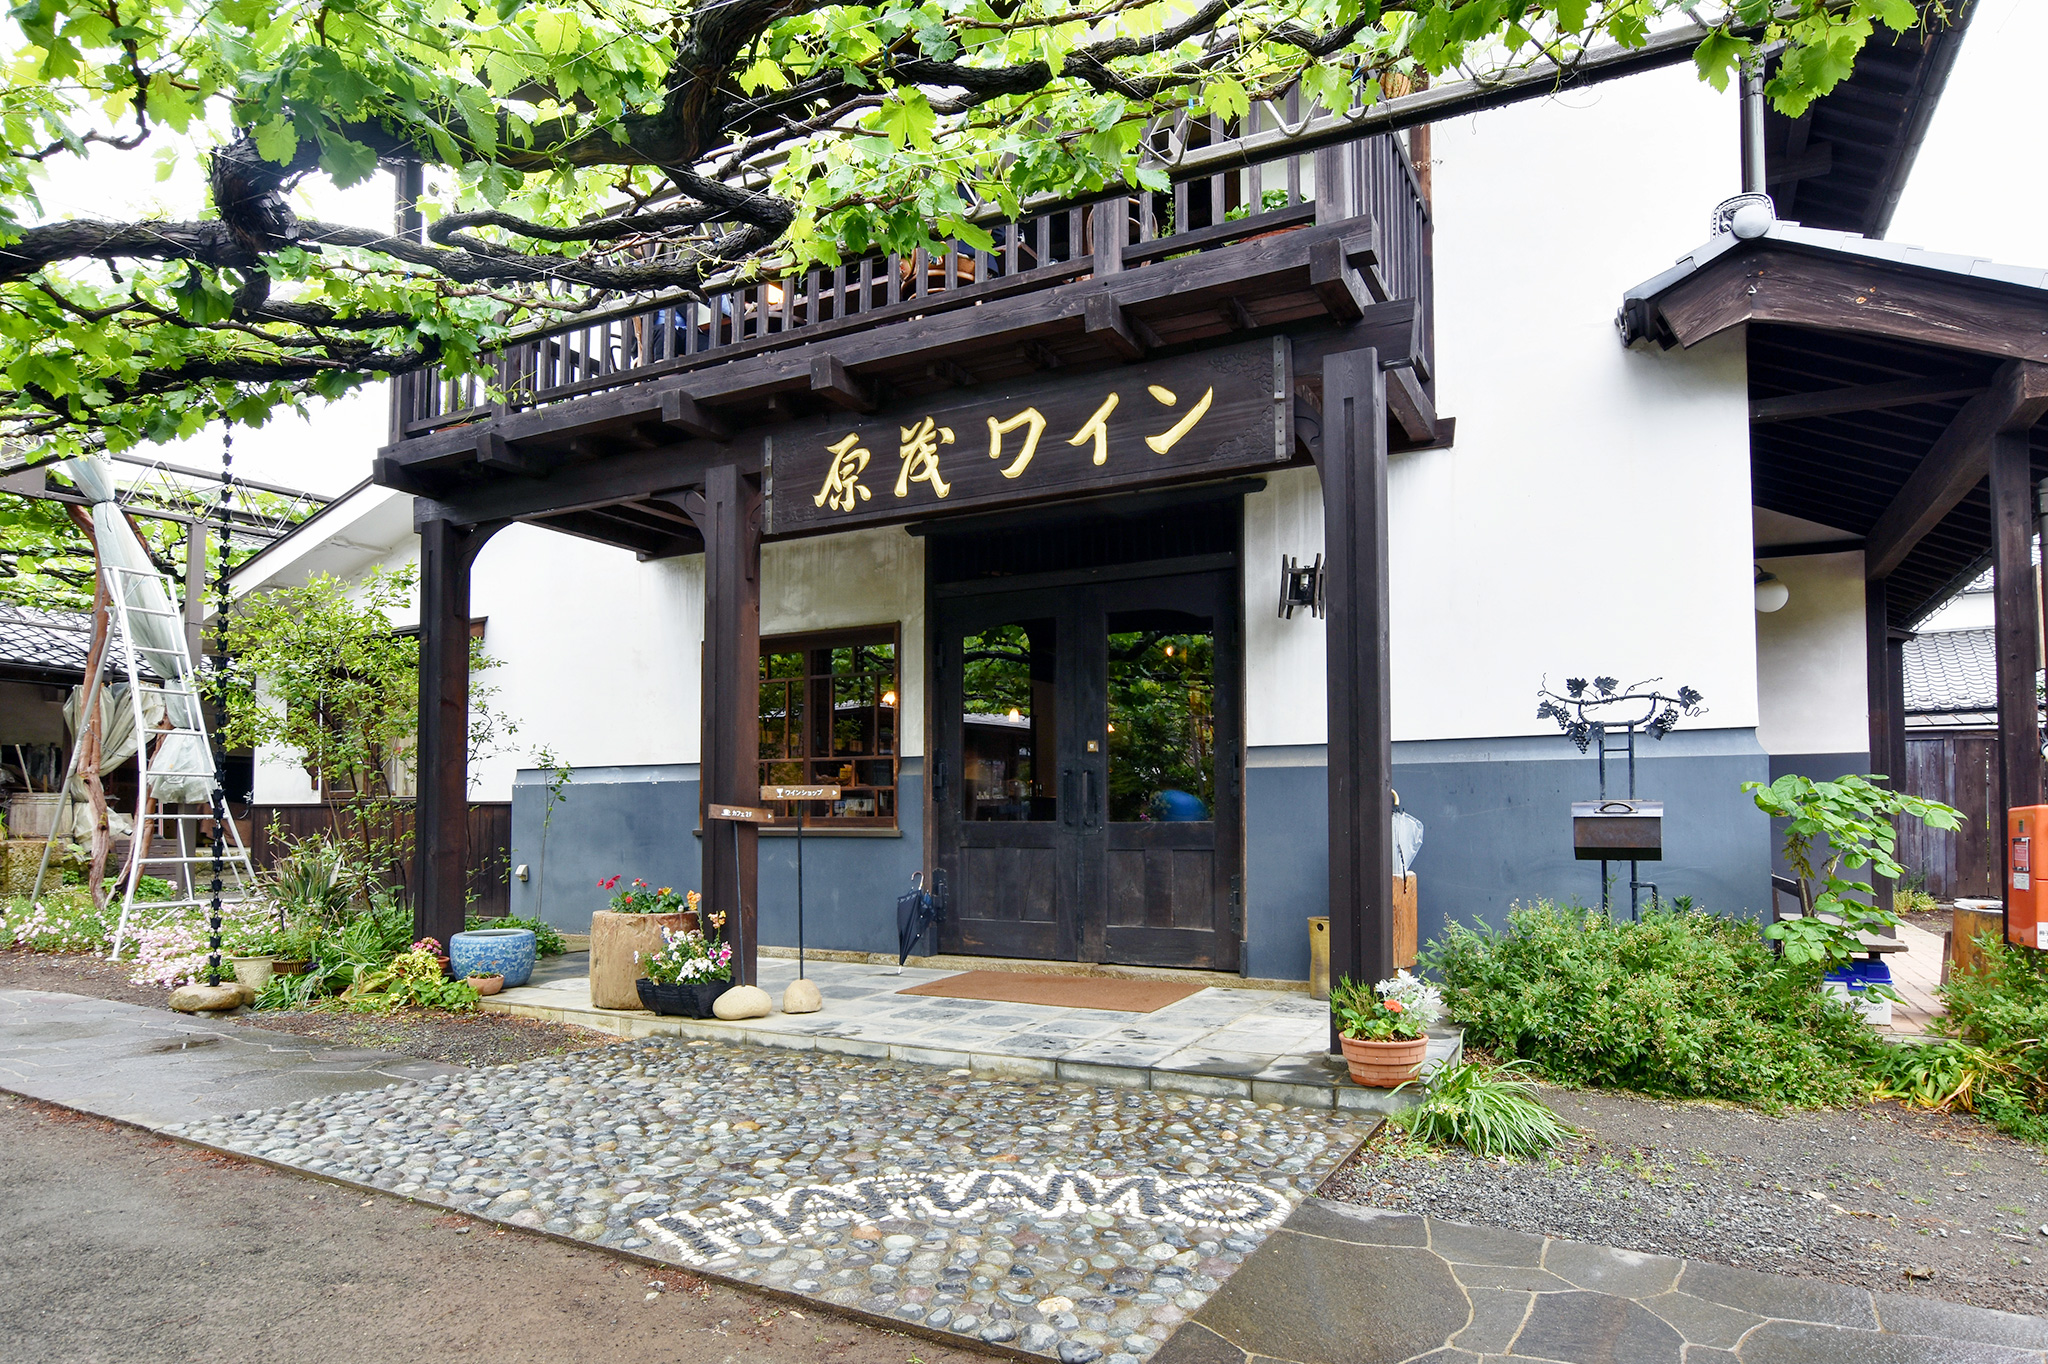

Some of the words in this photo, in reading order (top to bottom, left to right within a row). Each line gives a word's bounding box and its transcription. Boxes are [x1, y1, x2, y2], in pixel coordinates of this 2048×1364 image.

[812, 384, 1213, 512] 原茂ワイン
[785, 788, 823, 796] ワインショップ
[638, 1170, 1291, 1265] HARAMO
